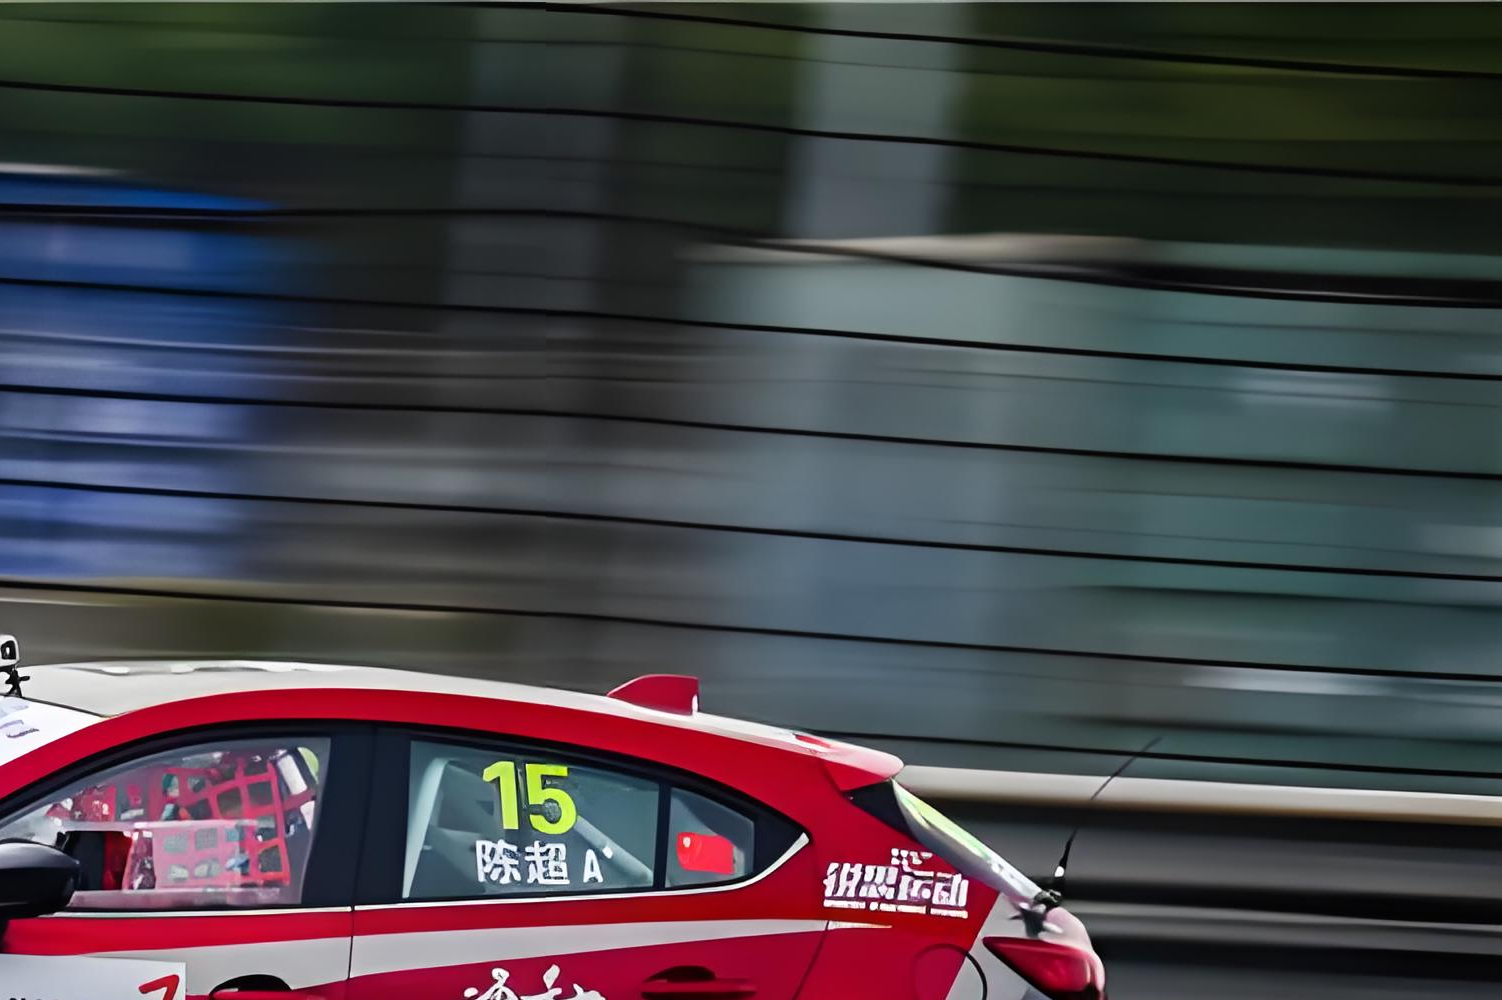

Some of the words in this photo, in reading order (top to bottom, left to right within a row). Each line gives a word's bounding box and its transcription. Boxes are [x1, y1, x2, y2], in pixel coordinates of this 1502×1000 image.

[482, 760, 577, 835] 15
[476, 840, 570, 885] 陈超
[583, 849, 604, 884] A
